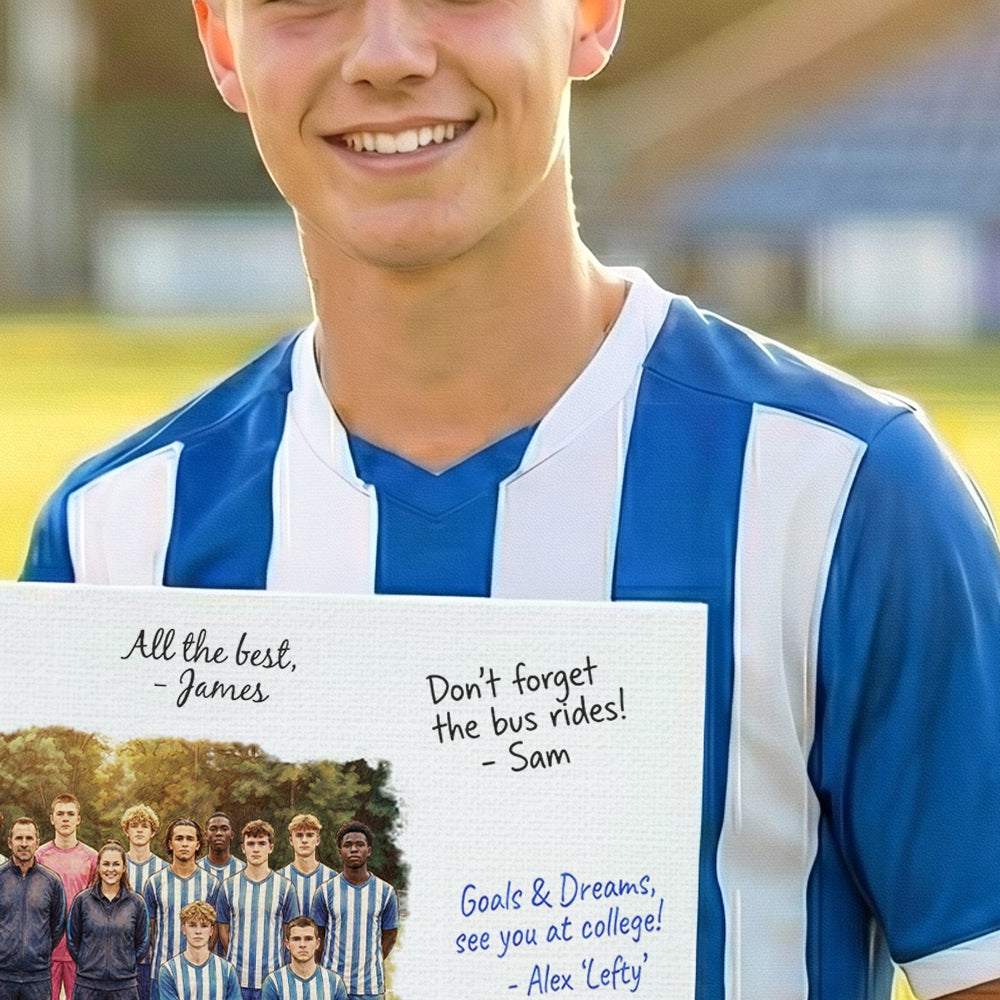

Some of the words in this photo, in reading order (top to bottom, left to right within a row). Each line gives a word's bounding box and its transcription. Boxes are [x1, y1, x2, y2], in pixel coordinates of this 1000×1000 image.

[119, 627, 177, 662] All
[181, 627, 229, 664] the
[235, 631, 297, 673] best,
[175, 667, 270, 709] James
[425, 665, 502, 706] Don't
[511, 655, 598, 707] forget
[431, 711, 481, 745] the
[490, 706, 539, 737] bus
[549, 686, 627, 728] rides!
[508, 740, 572, 773] Sam
[460, 880, 523, 918] Goals
[530, 876, 554, 909] &
[559, 871, 656, 909] Dreams,
[455, 931, 491, 955] see
[496, 928, 538, 959] you
[545, 915, 574, 943] at
[581, 897, 665, 944] college!
[526, 963, 575, 997] Alex
